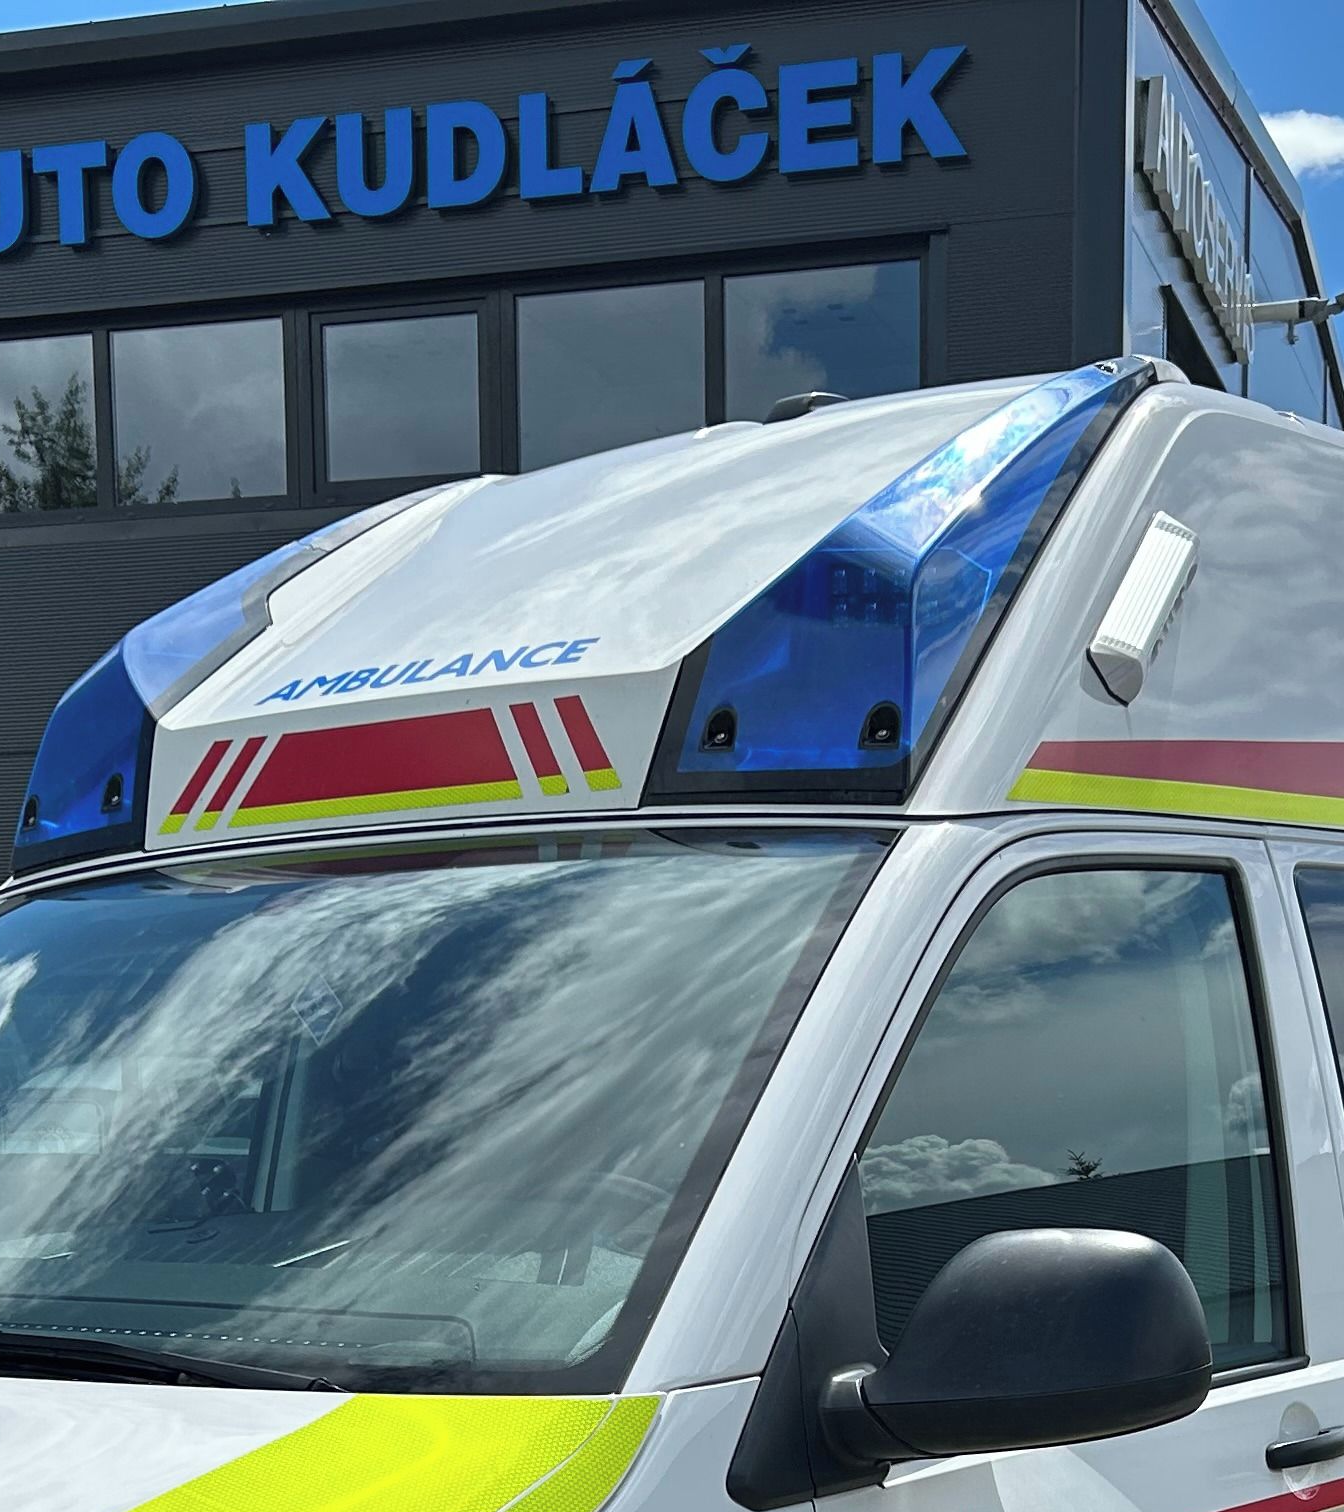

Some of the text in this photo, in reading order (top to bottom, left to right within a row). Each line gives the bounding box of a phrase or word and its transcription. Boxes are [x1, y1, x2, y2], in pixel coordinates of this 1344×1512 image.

[245, 44, 967, 226] KUDLÁČEK
[1143, 75, 1256, 365] AUTOSERVIS
[260, 637, 600, 705] AMBULANCE
